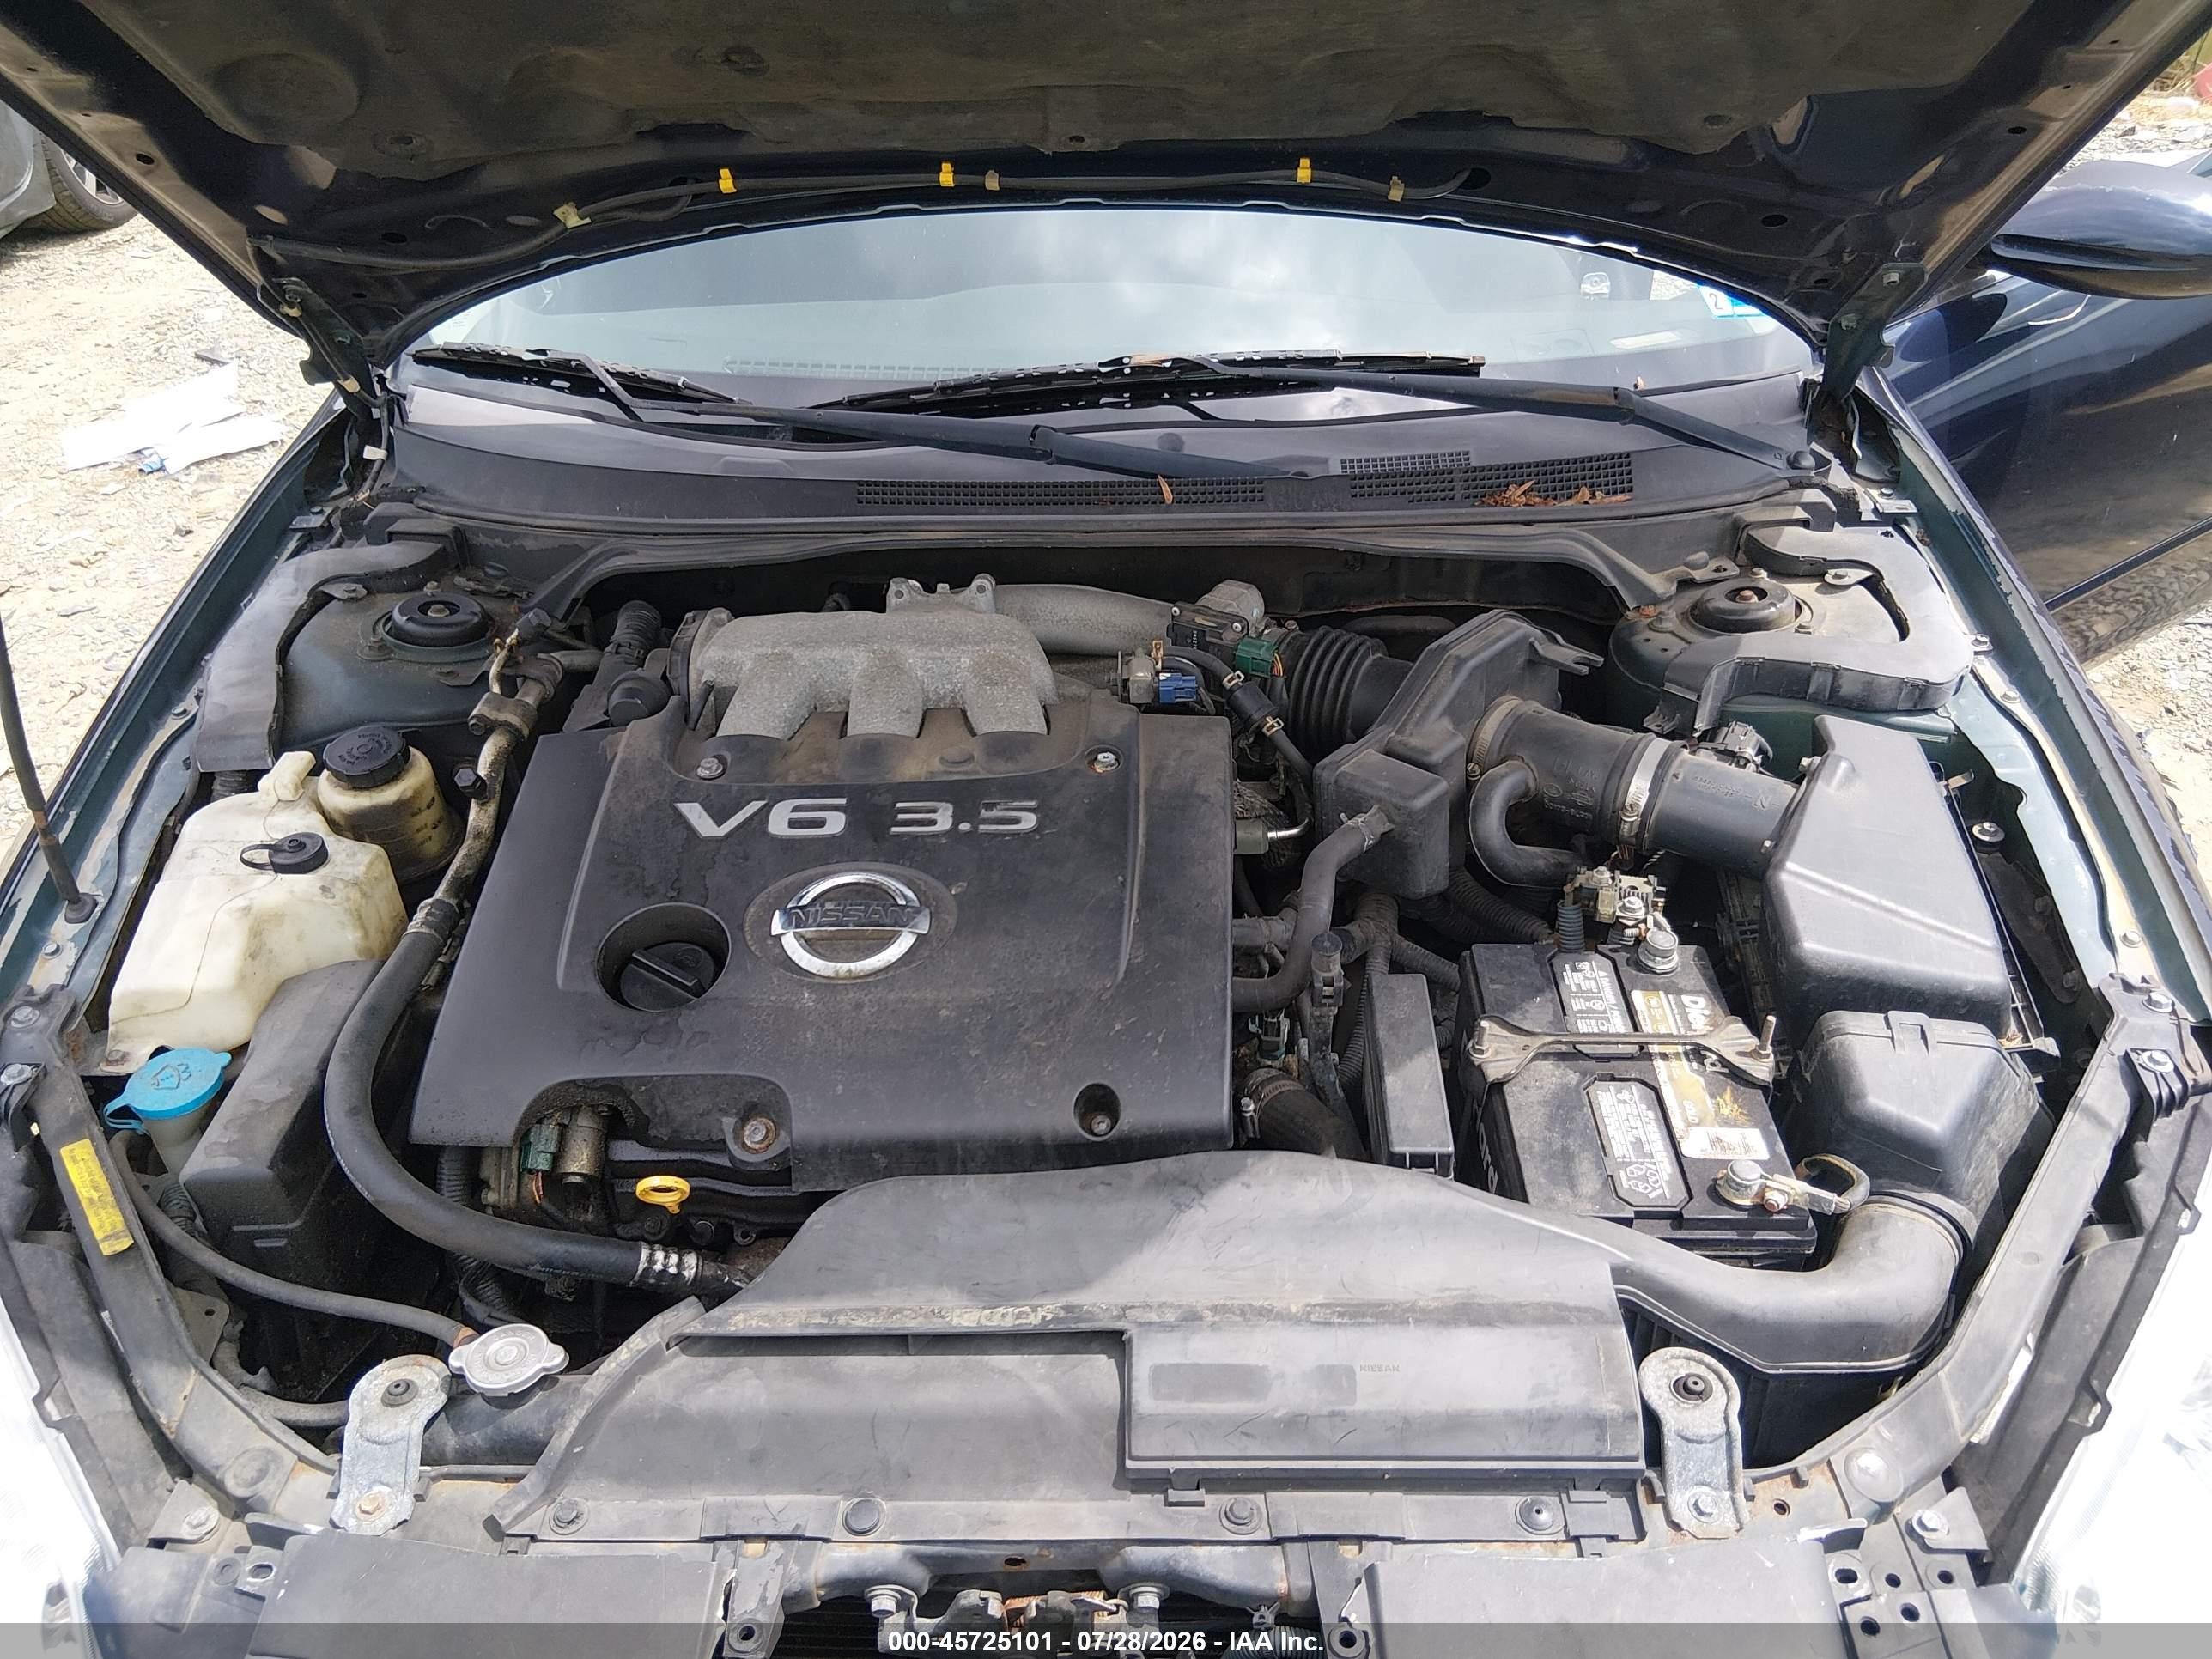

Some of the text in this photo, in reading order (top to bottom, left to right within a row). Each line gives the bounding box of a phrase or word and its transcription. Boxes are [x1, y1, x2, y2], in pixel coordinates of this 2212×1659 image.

[674, 798, 1039, 838] V6 3.5
[788, 906, 914, 930] NISSAN
[1359, 1364, 1401, 1372] NISSAN
